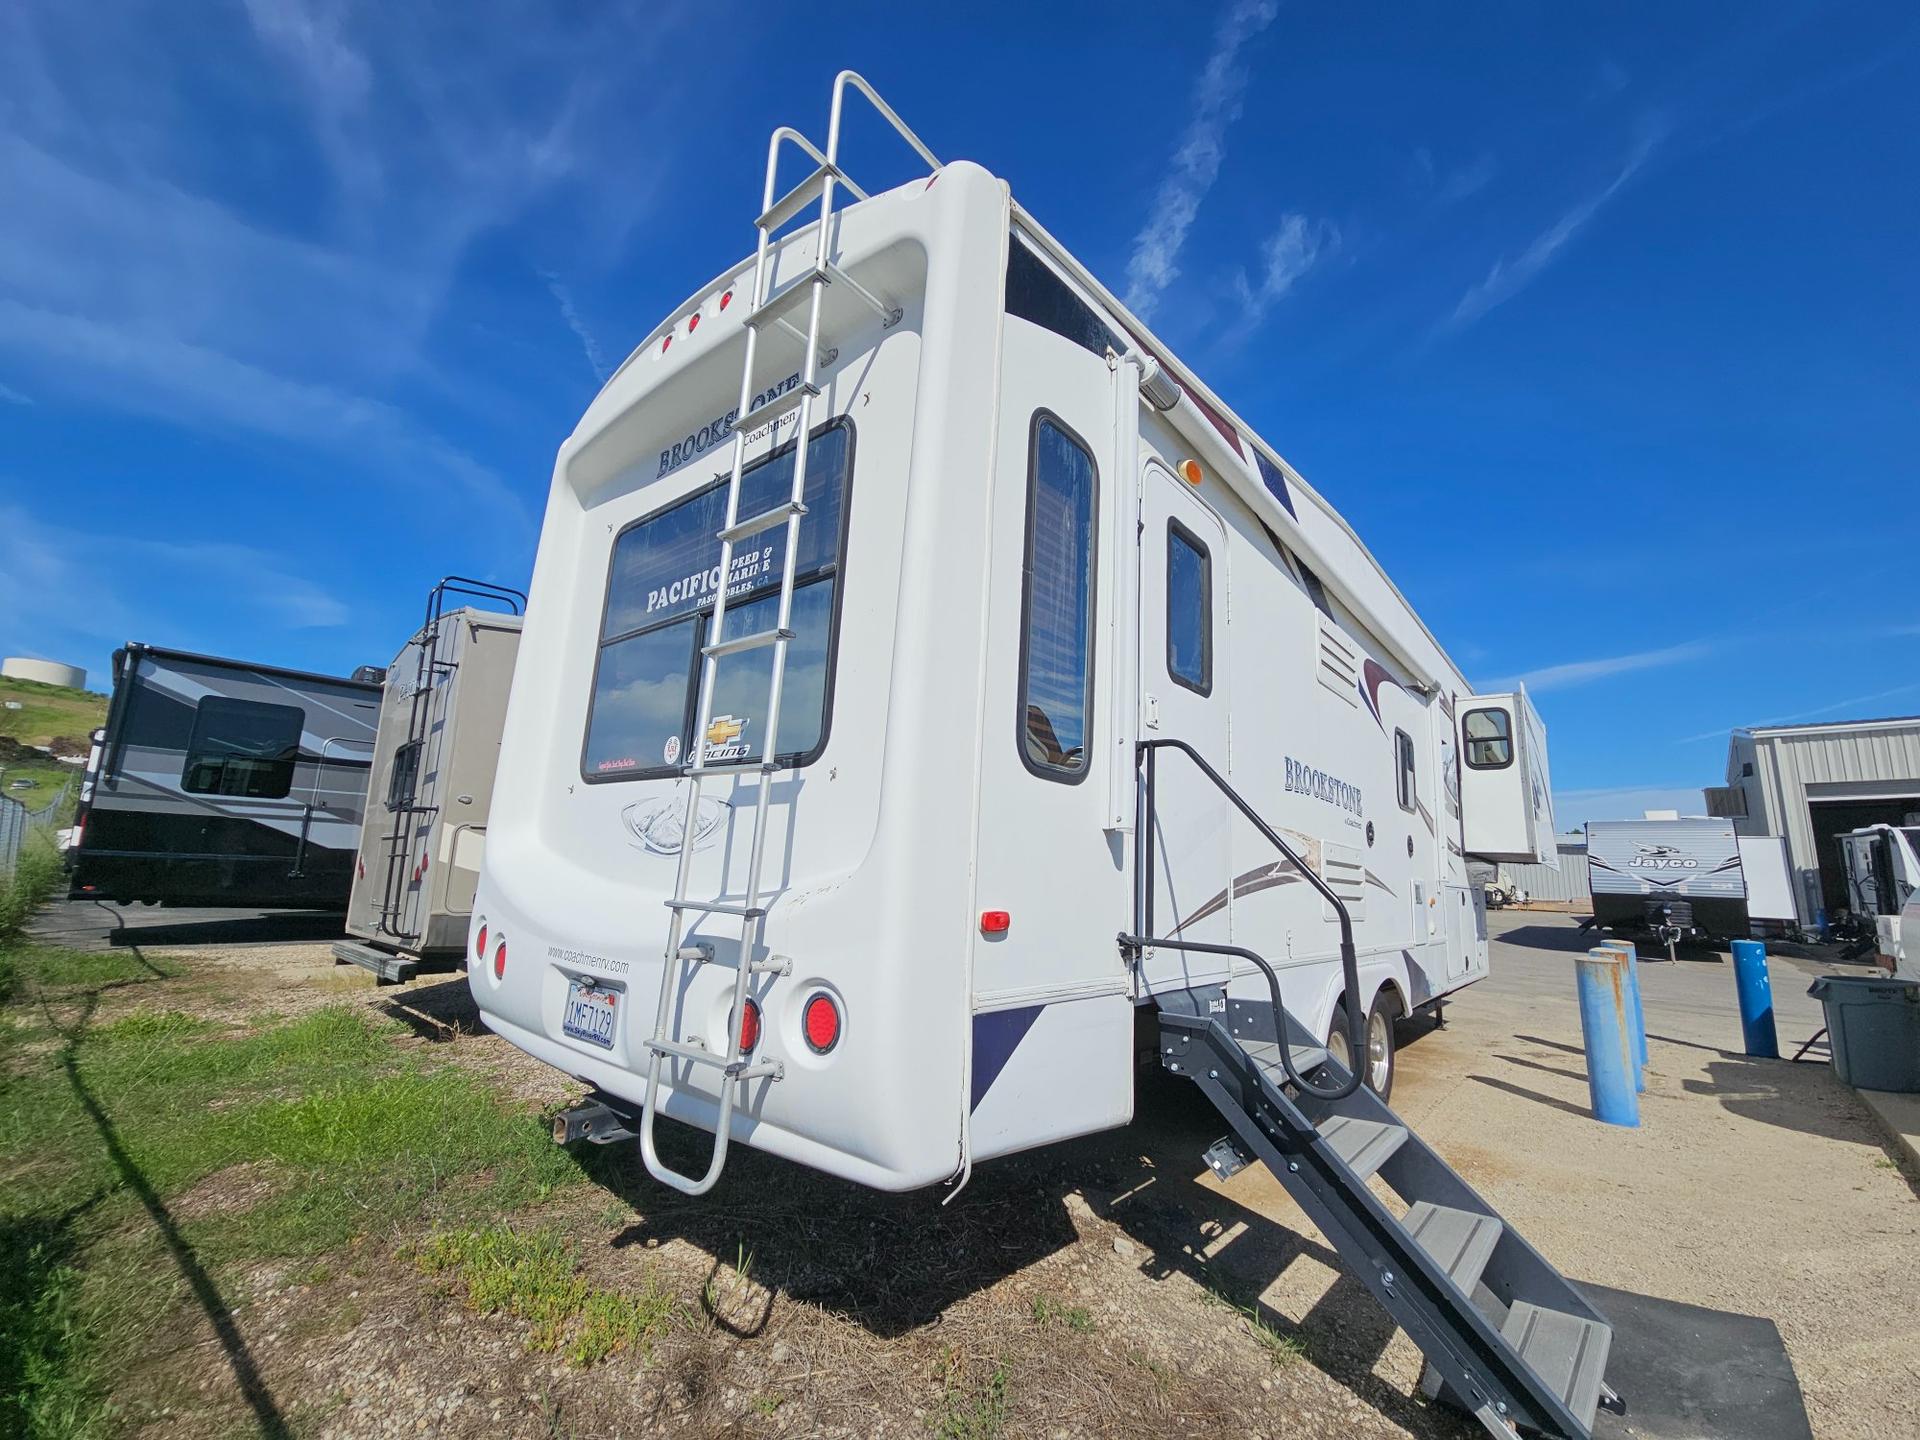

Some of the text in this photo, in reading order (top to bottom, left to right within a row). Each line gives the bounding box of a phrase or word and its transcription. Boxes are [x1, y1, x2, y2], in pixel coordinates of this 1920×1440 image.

[656, 372, 800, 479] BROOKSONE
[730, 547, 773, 571] PEED &
[646, 566, 722, 613] PACIFIC
[697, 593, 717, 607] PASO
[725, 581, 755, 599] OBLES,
[1284, 756, 1362, 818] BROOKSTONE
[1628, 856, 1698, 870] Jayco
[548, 945, 630, 974] www.coachmenrv.com
[567, 1001, 612, 1037] 1MF7129
